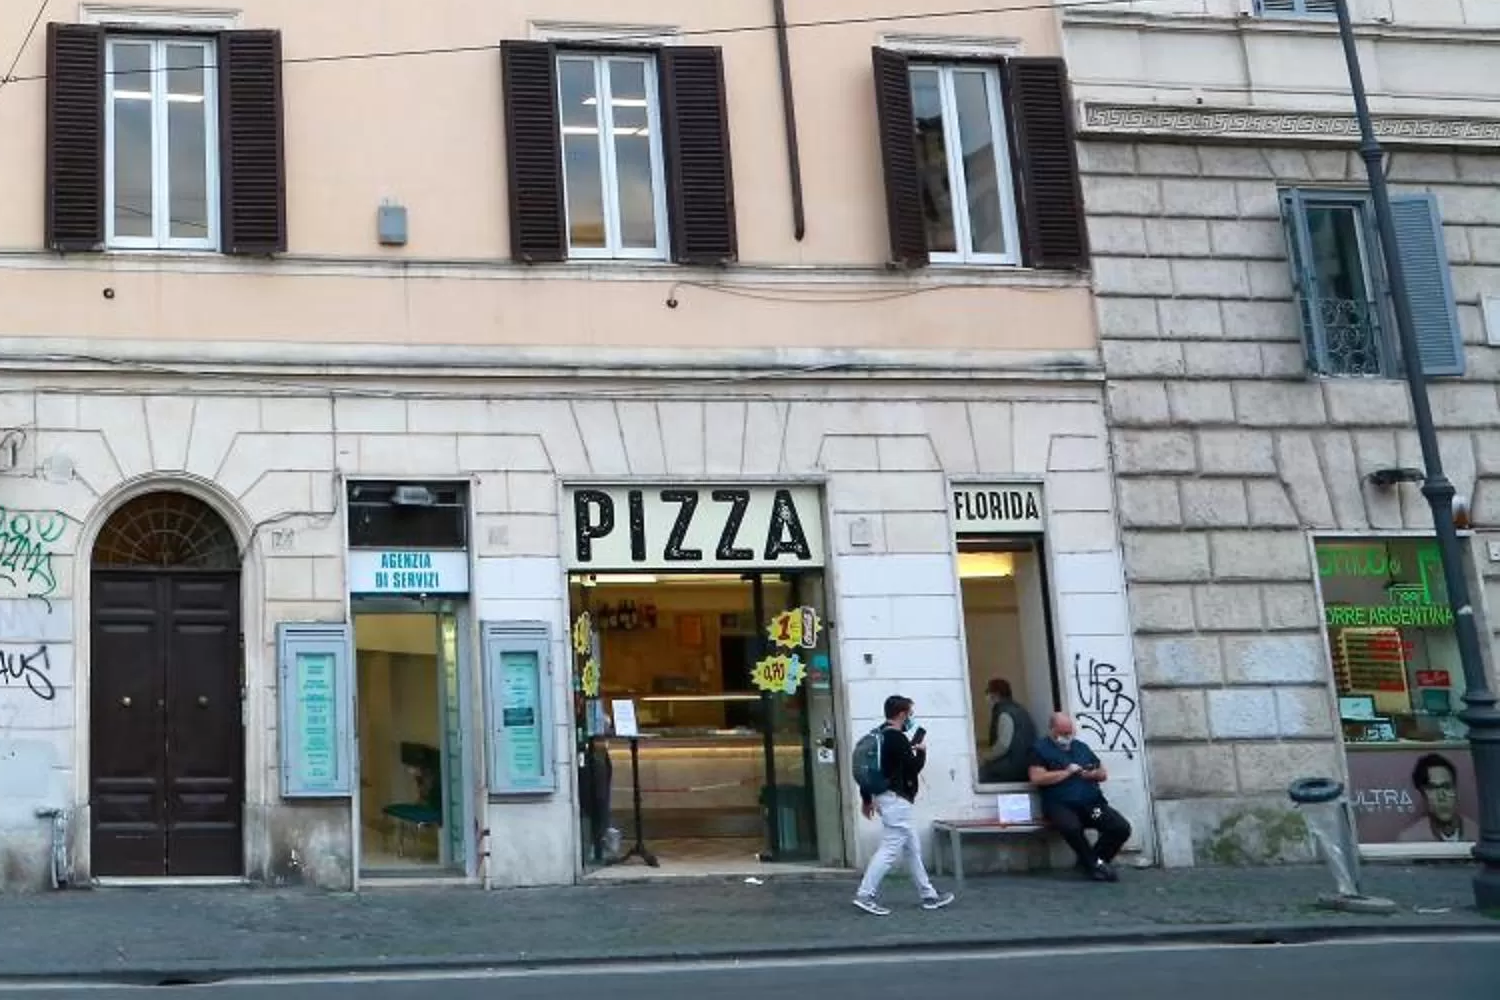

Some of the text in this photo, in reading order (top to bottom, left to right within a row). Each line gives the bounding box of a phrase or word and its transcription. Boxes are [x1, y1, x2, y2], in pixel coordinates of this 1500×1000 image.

[953, 491, 1040, 520] FLORIDA
[574, 489, 812, 562] PIZZA
[381, 553, 432, 569] AGENZIA
[375, 571, 440, 588] DI SERVIZI
[1369, 607, 1455, 626] ARGENTINA
